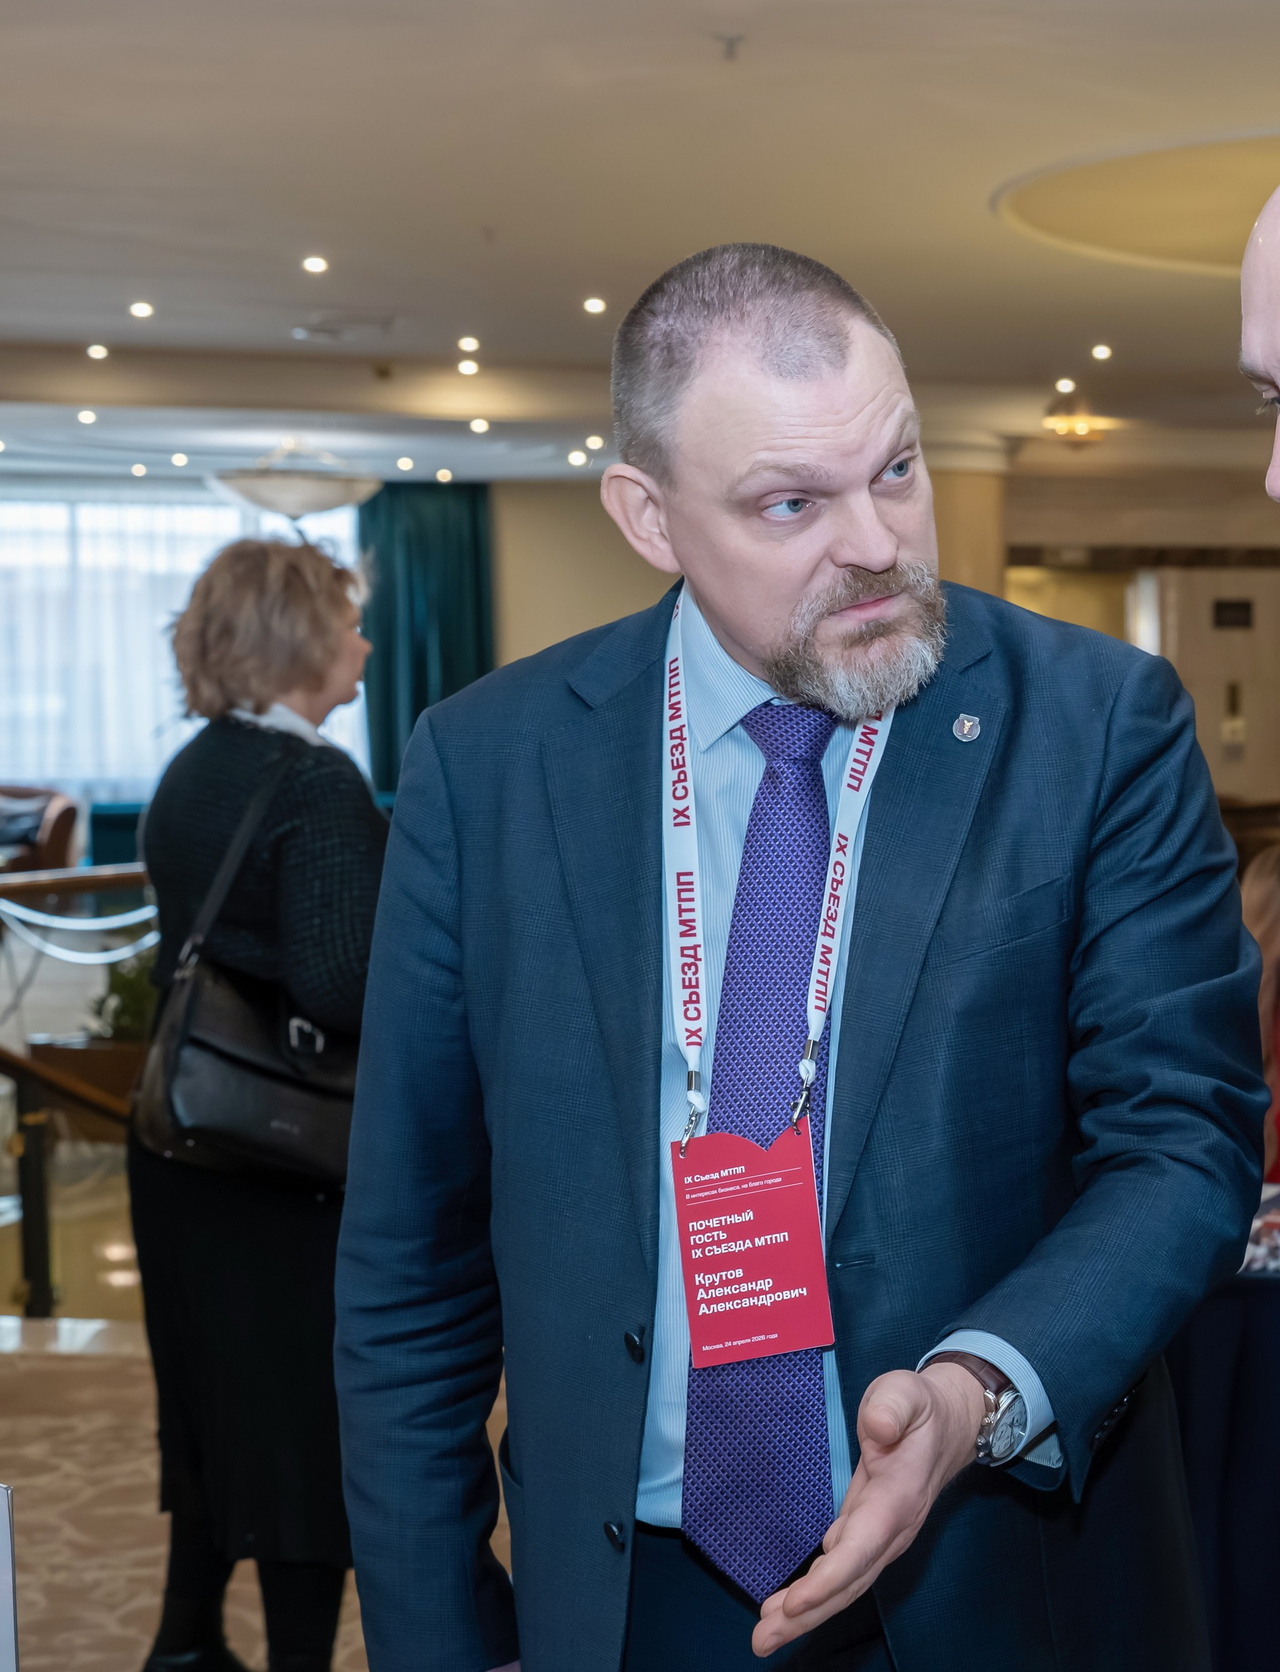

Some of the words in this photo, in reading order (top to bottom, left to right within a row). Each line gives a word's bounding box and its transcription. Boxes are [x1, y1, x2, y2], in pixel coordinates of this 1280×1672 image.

[668, 656, 682, 722] МТПП
[670, 724, 689, 801] СЪЕЗД
[846, 724, 879, 793] МТПП
[673, 805, 691, 827] IX
[835, 832, 849, 857] IX
[676, 871, 697, 938] МТПП
[820, 861, 845, 940] СЪЕЗД
[680, 944, 702, 1022] СЪЕЗД
[814, 943, 834, 1013] МТПП
[685, 1026, 702, 1047] IX
[684, 1176, 693, 1184] IX
[694, 1170, 720, 1183] Съезд
[720, 1165, 746, 1177] МТПП
[688, 1209, 754, 1232] ПОЧЕТНЫЙ
[690, 1230, 727, 1245] ГОСТЬ
[692, 1249, 703, 1259] IX
[705, 1239, 753, 1257] СЪЕЗДА
[754, 1232, 789, 1247] МТПП
[694, 1268, 744, 1287] Крутов
[697, 1278, 773, 1301] Александр
[698, 1287, 807, 1316] Александрович
